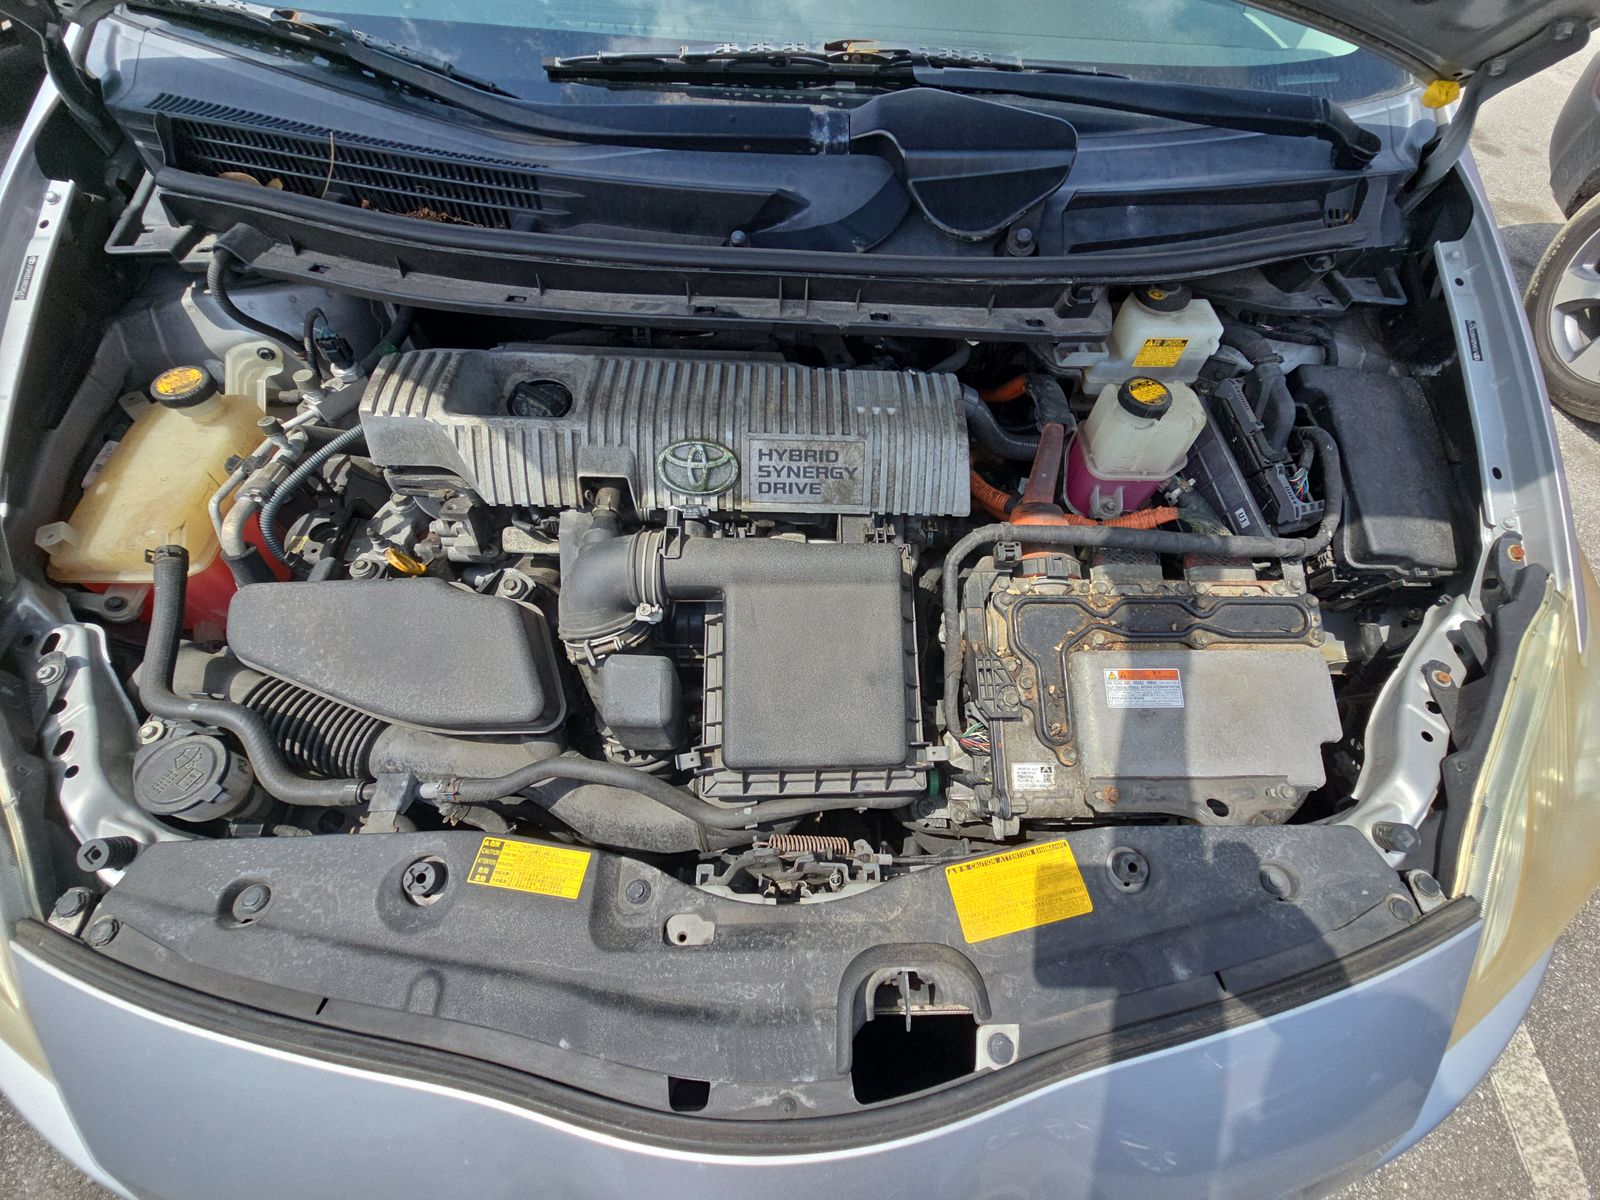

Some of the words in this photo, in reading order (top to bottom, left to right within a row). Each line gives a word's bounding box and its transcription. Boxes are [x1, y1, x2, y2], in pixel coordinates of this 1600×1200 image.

[758, 448, 838, 463] HYBRID
[757, 465, 858, 480] SYNERGY
[758, 482, 822, 494] DRIVE
[481, 847, 501, 856] CAUTION
[972, 858, 996, 868] CAUTION
[1000, 850, 1031, 862] ATTENTION
